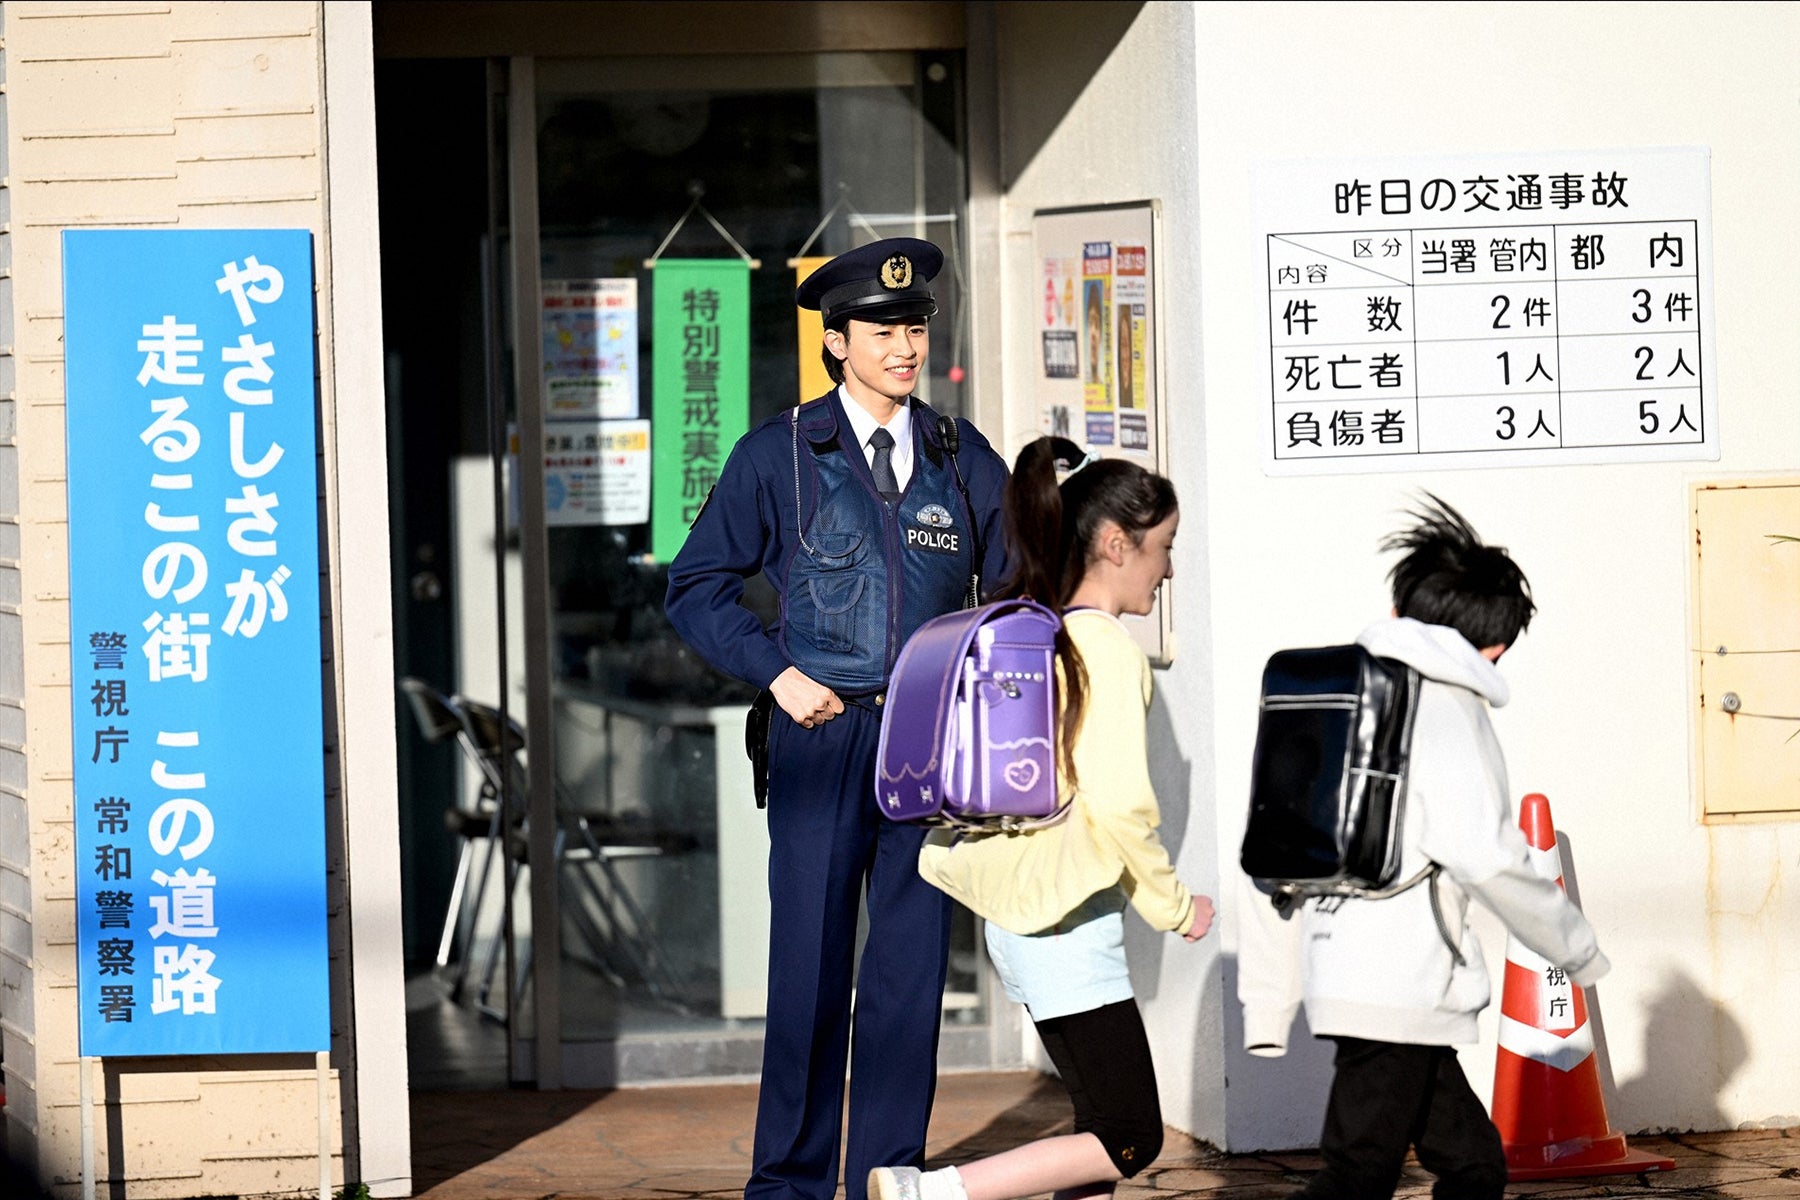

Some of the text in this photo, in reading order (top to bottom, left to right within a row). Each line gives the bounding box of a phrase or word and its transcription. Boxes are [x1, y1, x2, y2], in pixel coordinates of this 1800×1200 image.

[1334, 170, 1629, 217] 昨日の交通事故
[1353, 237, 1402, 258] 区分
[1278, 264, 1328, 285] 内容
[1284, 352, 1404, 392] 死亡者
[215, 255, 292, 639] やさしさが
[1286, 408, 1406, 448] 負傷者
[907, 529, 959, 551] POLICE
[136, 315, 222, 1015] 走るこの街 この道路
[89, 631, 136, 1023] 警視庁 常和警察署
